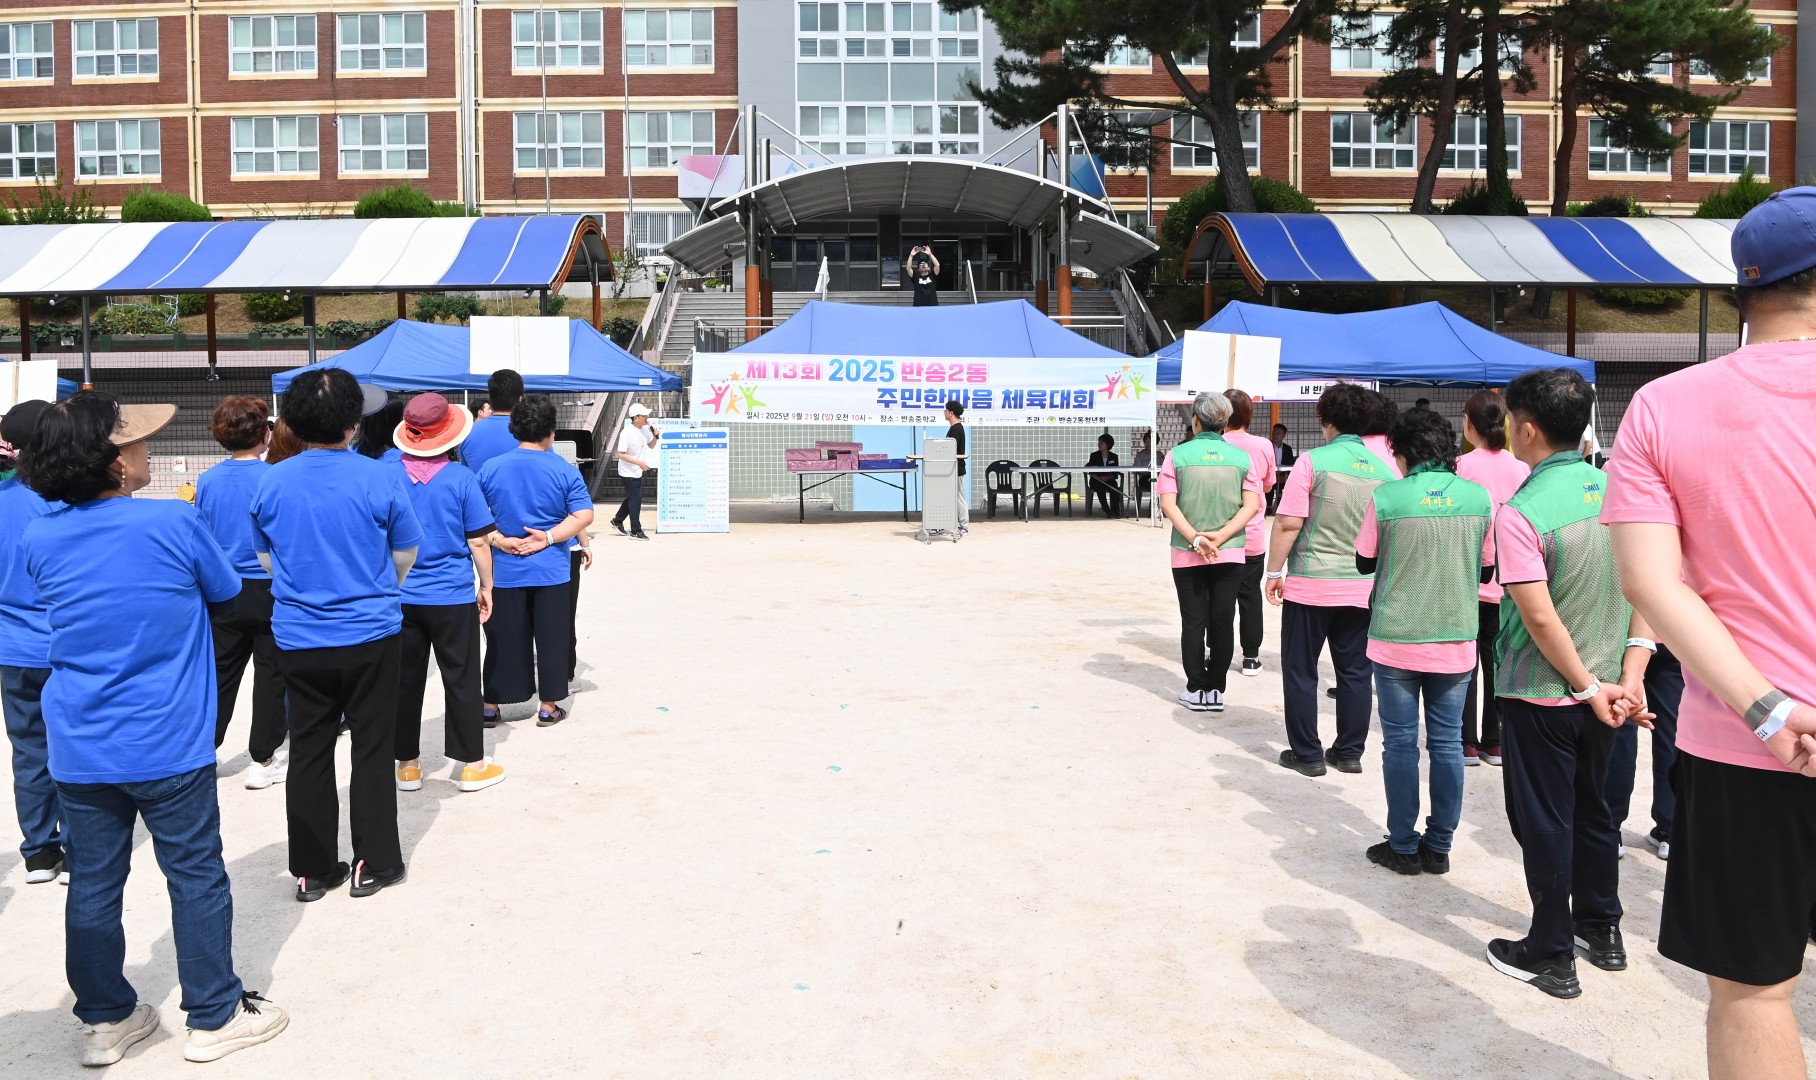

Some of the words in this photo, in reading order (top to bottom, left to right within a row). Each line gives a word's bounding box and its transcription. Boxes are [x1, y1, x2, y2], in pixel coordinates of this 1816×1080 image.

[746, 360, 821, 381] 제13회
[828, 358, 895, 383] 2025
[901, 361, 988, 383] 반송2동
[877, 387, 993, 410] 주민한마음
[1001, 388, 1095, 410] 체육대회
[746, 411, 760, 420] 일시
[765, 412, 789, 421] 2025년
[791, 412, 803, 421] 9월
[804, 412, 820, 421] 21일
[821, 412, 834, 422] (일)
[835, 413, 849, 422] 오전
[851, 413, 866, 422] 10시
[880, 414, 894, 423] 장소
[900, 415, 937, 424] 반송중학교
[1026, 416, 1041, 424] 주관
[1058, 416, 1106, 424] 반송2동청년회
[1426, 489, 1443, 497] SMU
[1419, 496, 1454, 508] 새마을
